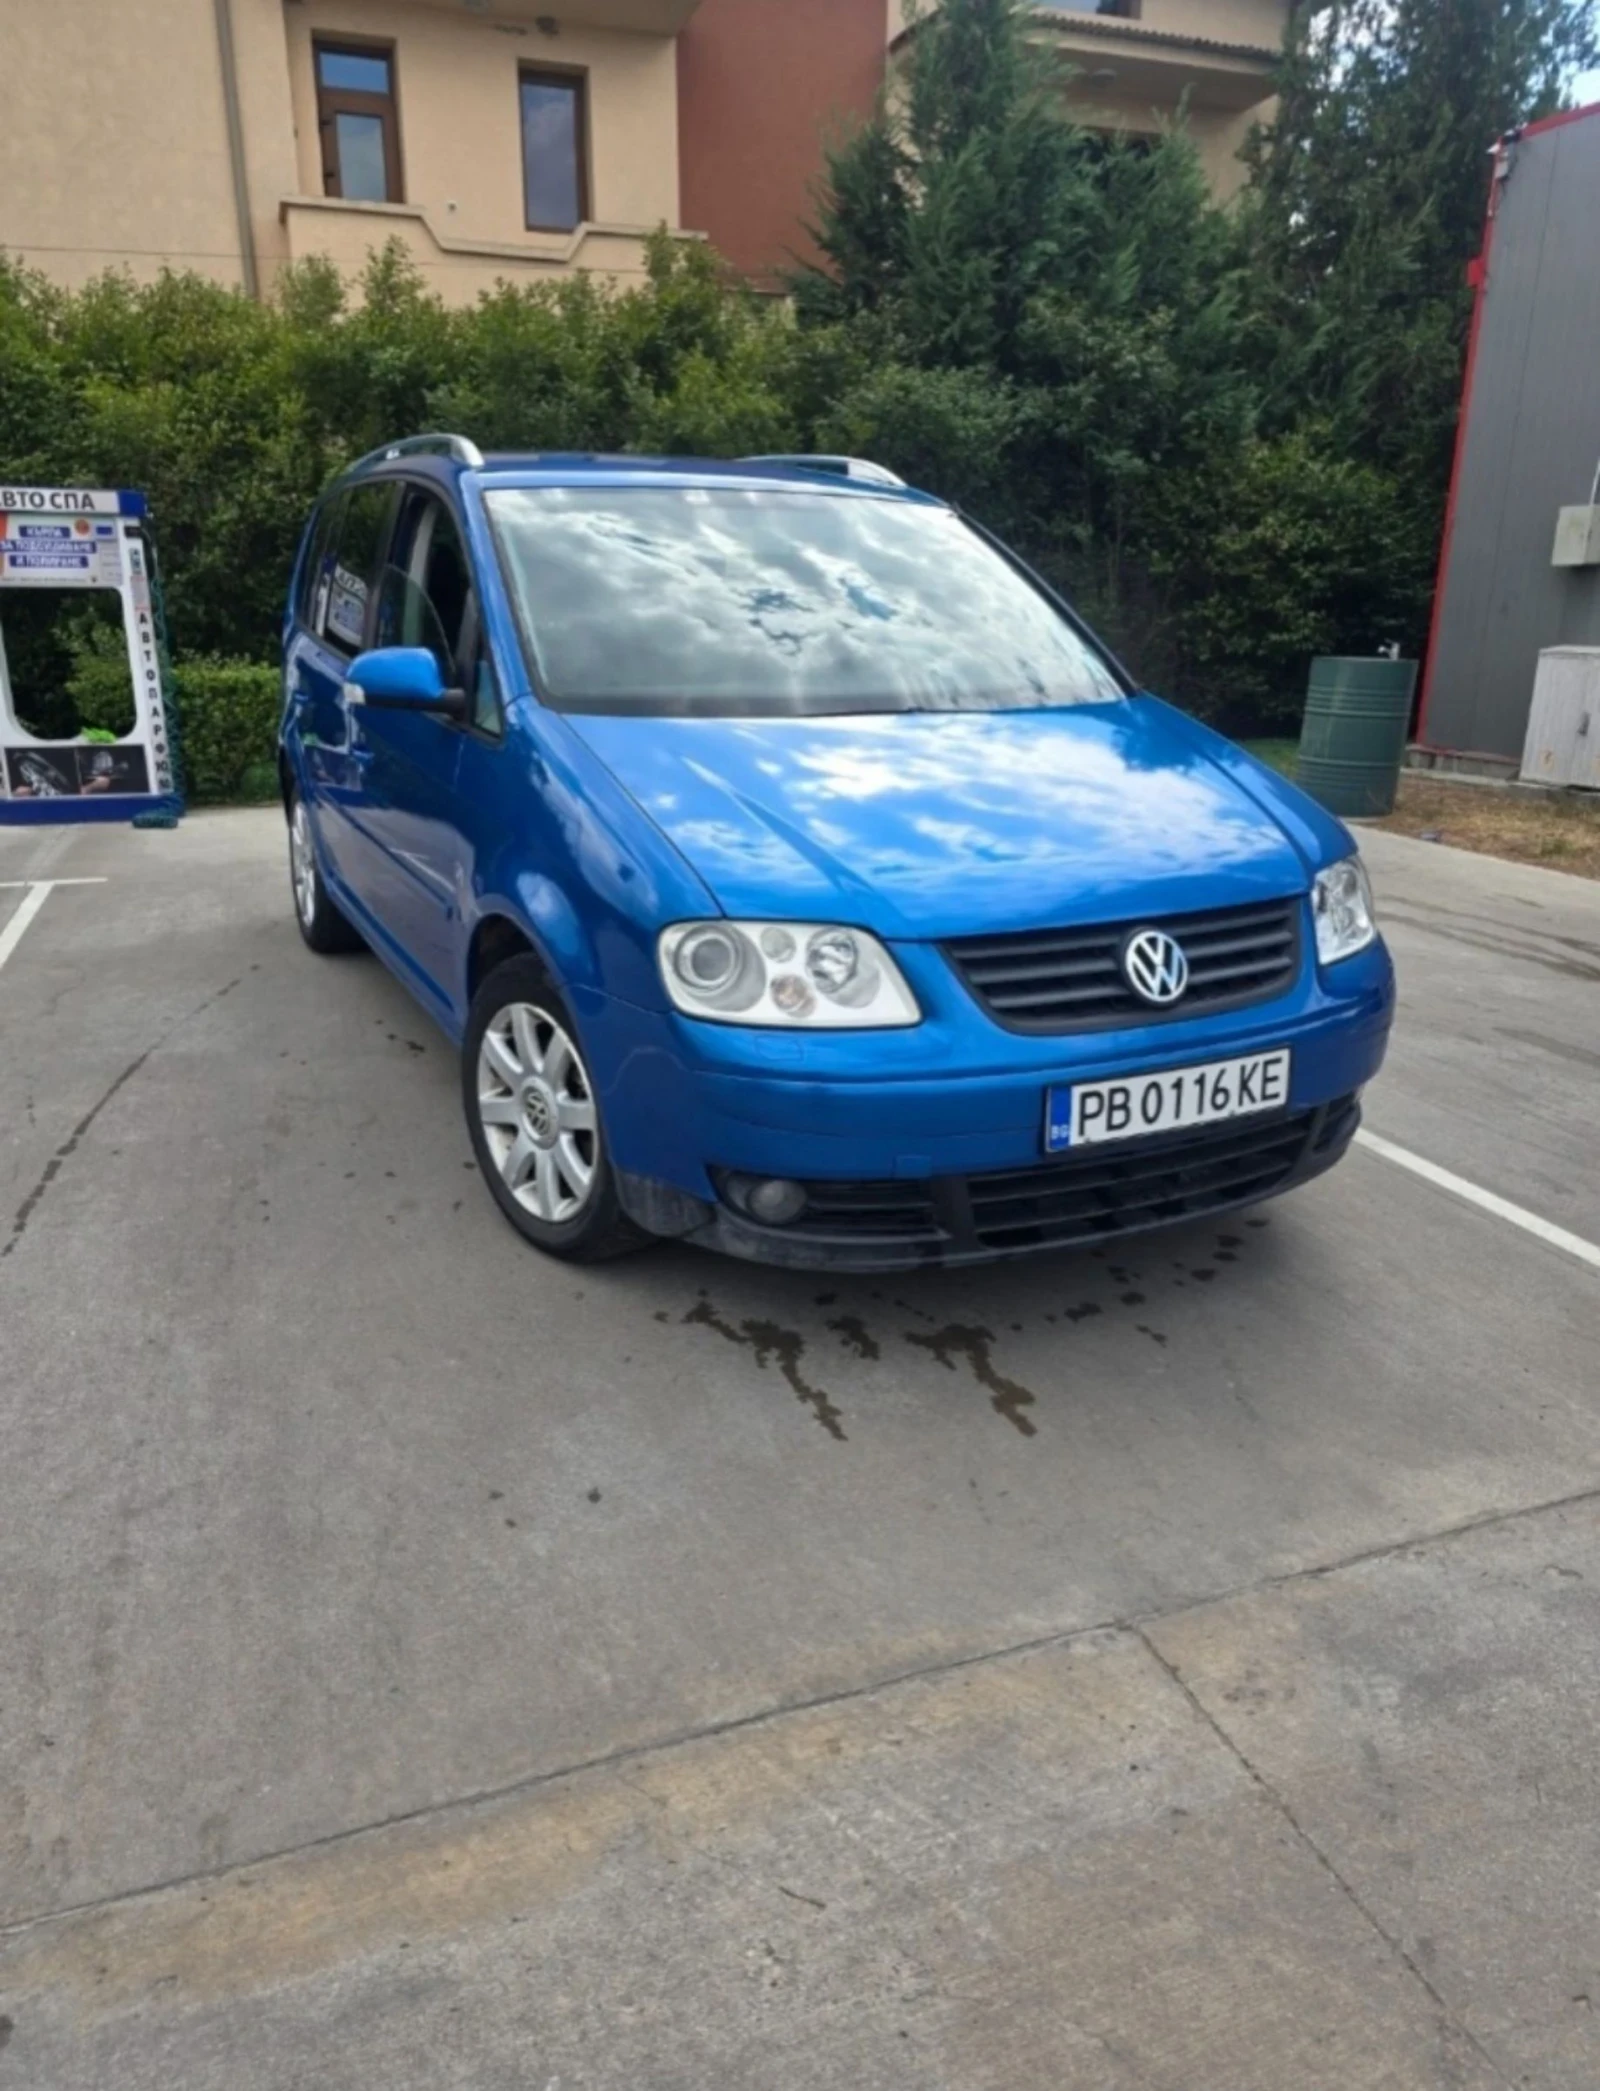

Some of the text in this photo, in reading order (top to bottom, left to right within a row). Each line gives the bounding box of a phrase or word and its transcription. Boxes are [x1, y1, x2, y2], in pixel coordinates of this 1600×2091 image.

[0, 491, 95, 510] ВТО СПА
[1051, 1124, 1069, 1140] BG
